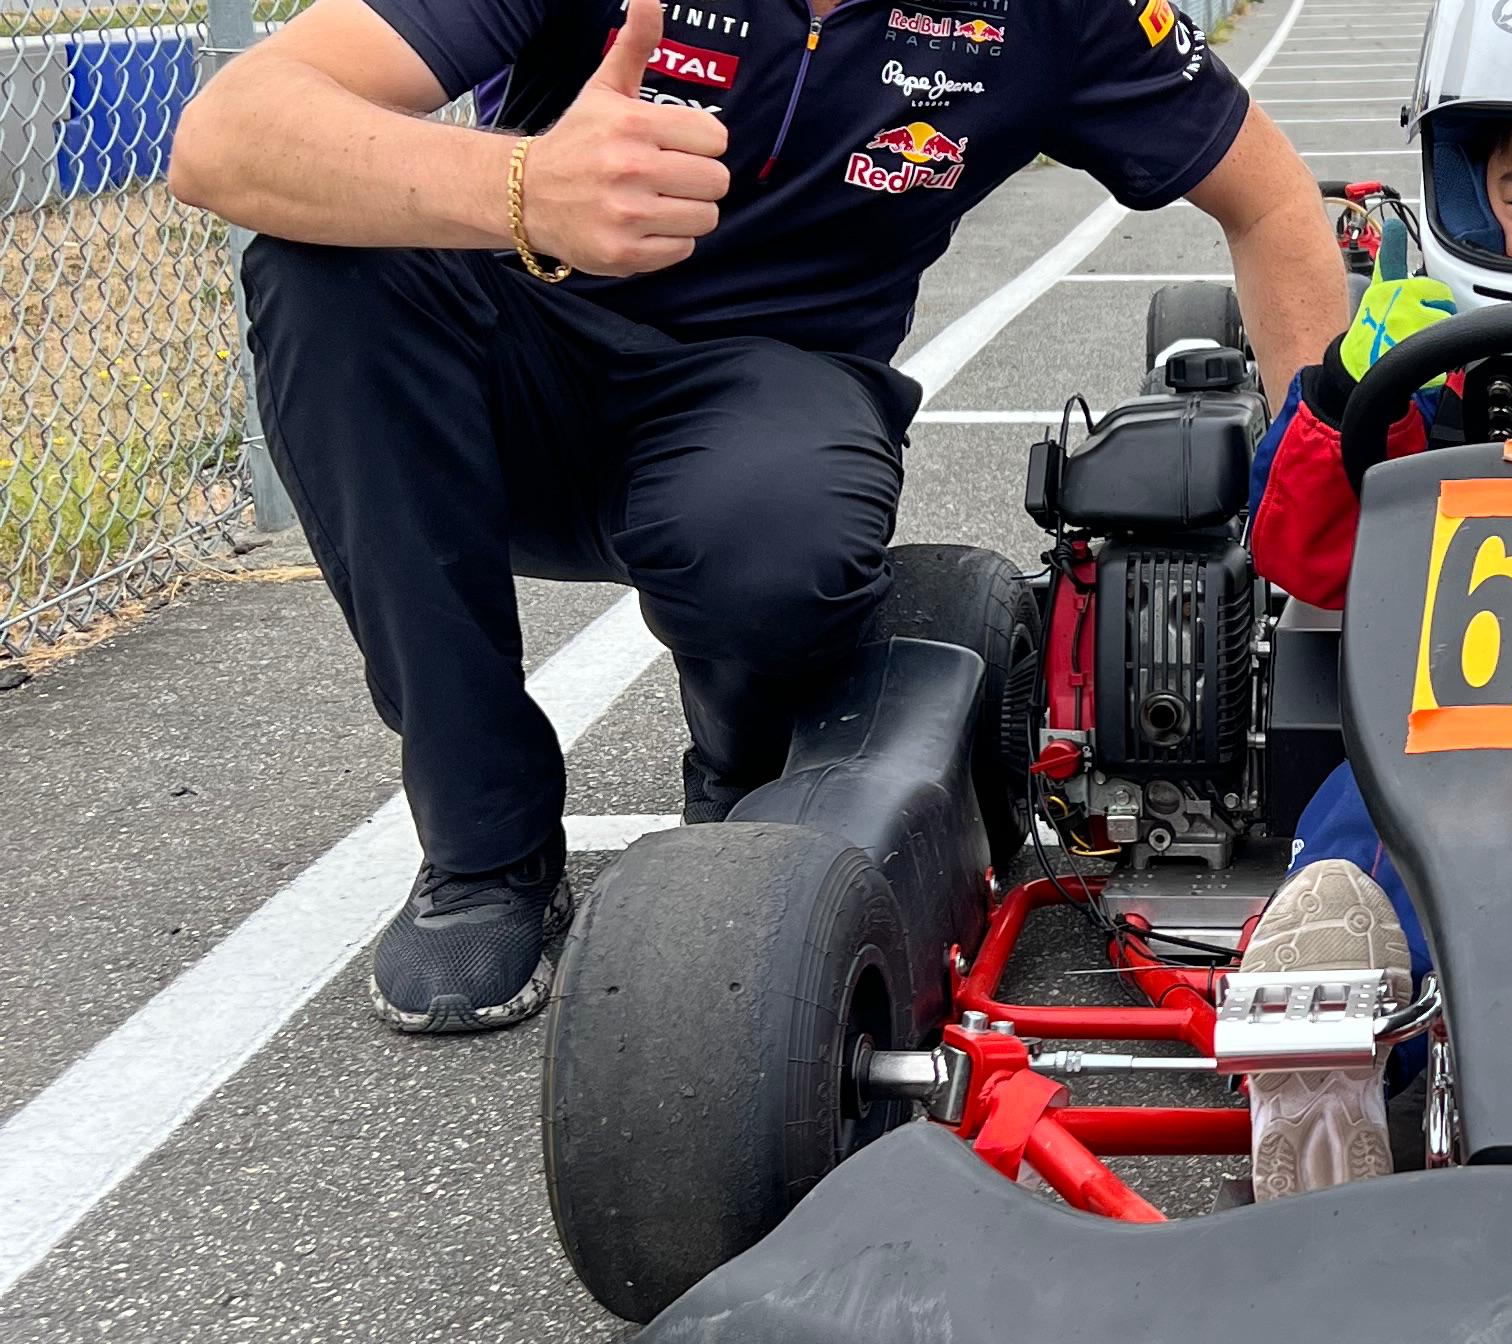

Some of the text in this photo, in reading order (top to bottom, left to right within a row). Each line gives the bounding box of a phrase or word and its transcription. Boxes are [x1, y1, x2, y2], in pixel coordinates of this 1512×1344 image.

[888, 8, 952, 37] Red Bull
[885, 30, 1002, 57] RACING
[881, 59, 985, 101] Pepe Jeans
[844, 152, 965, 194] Red Bull
